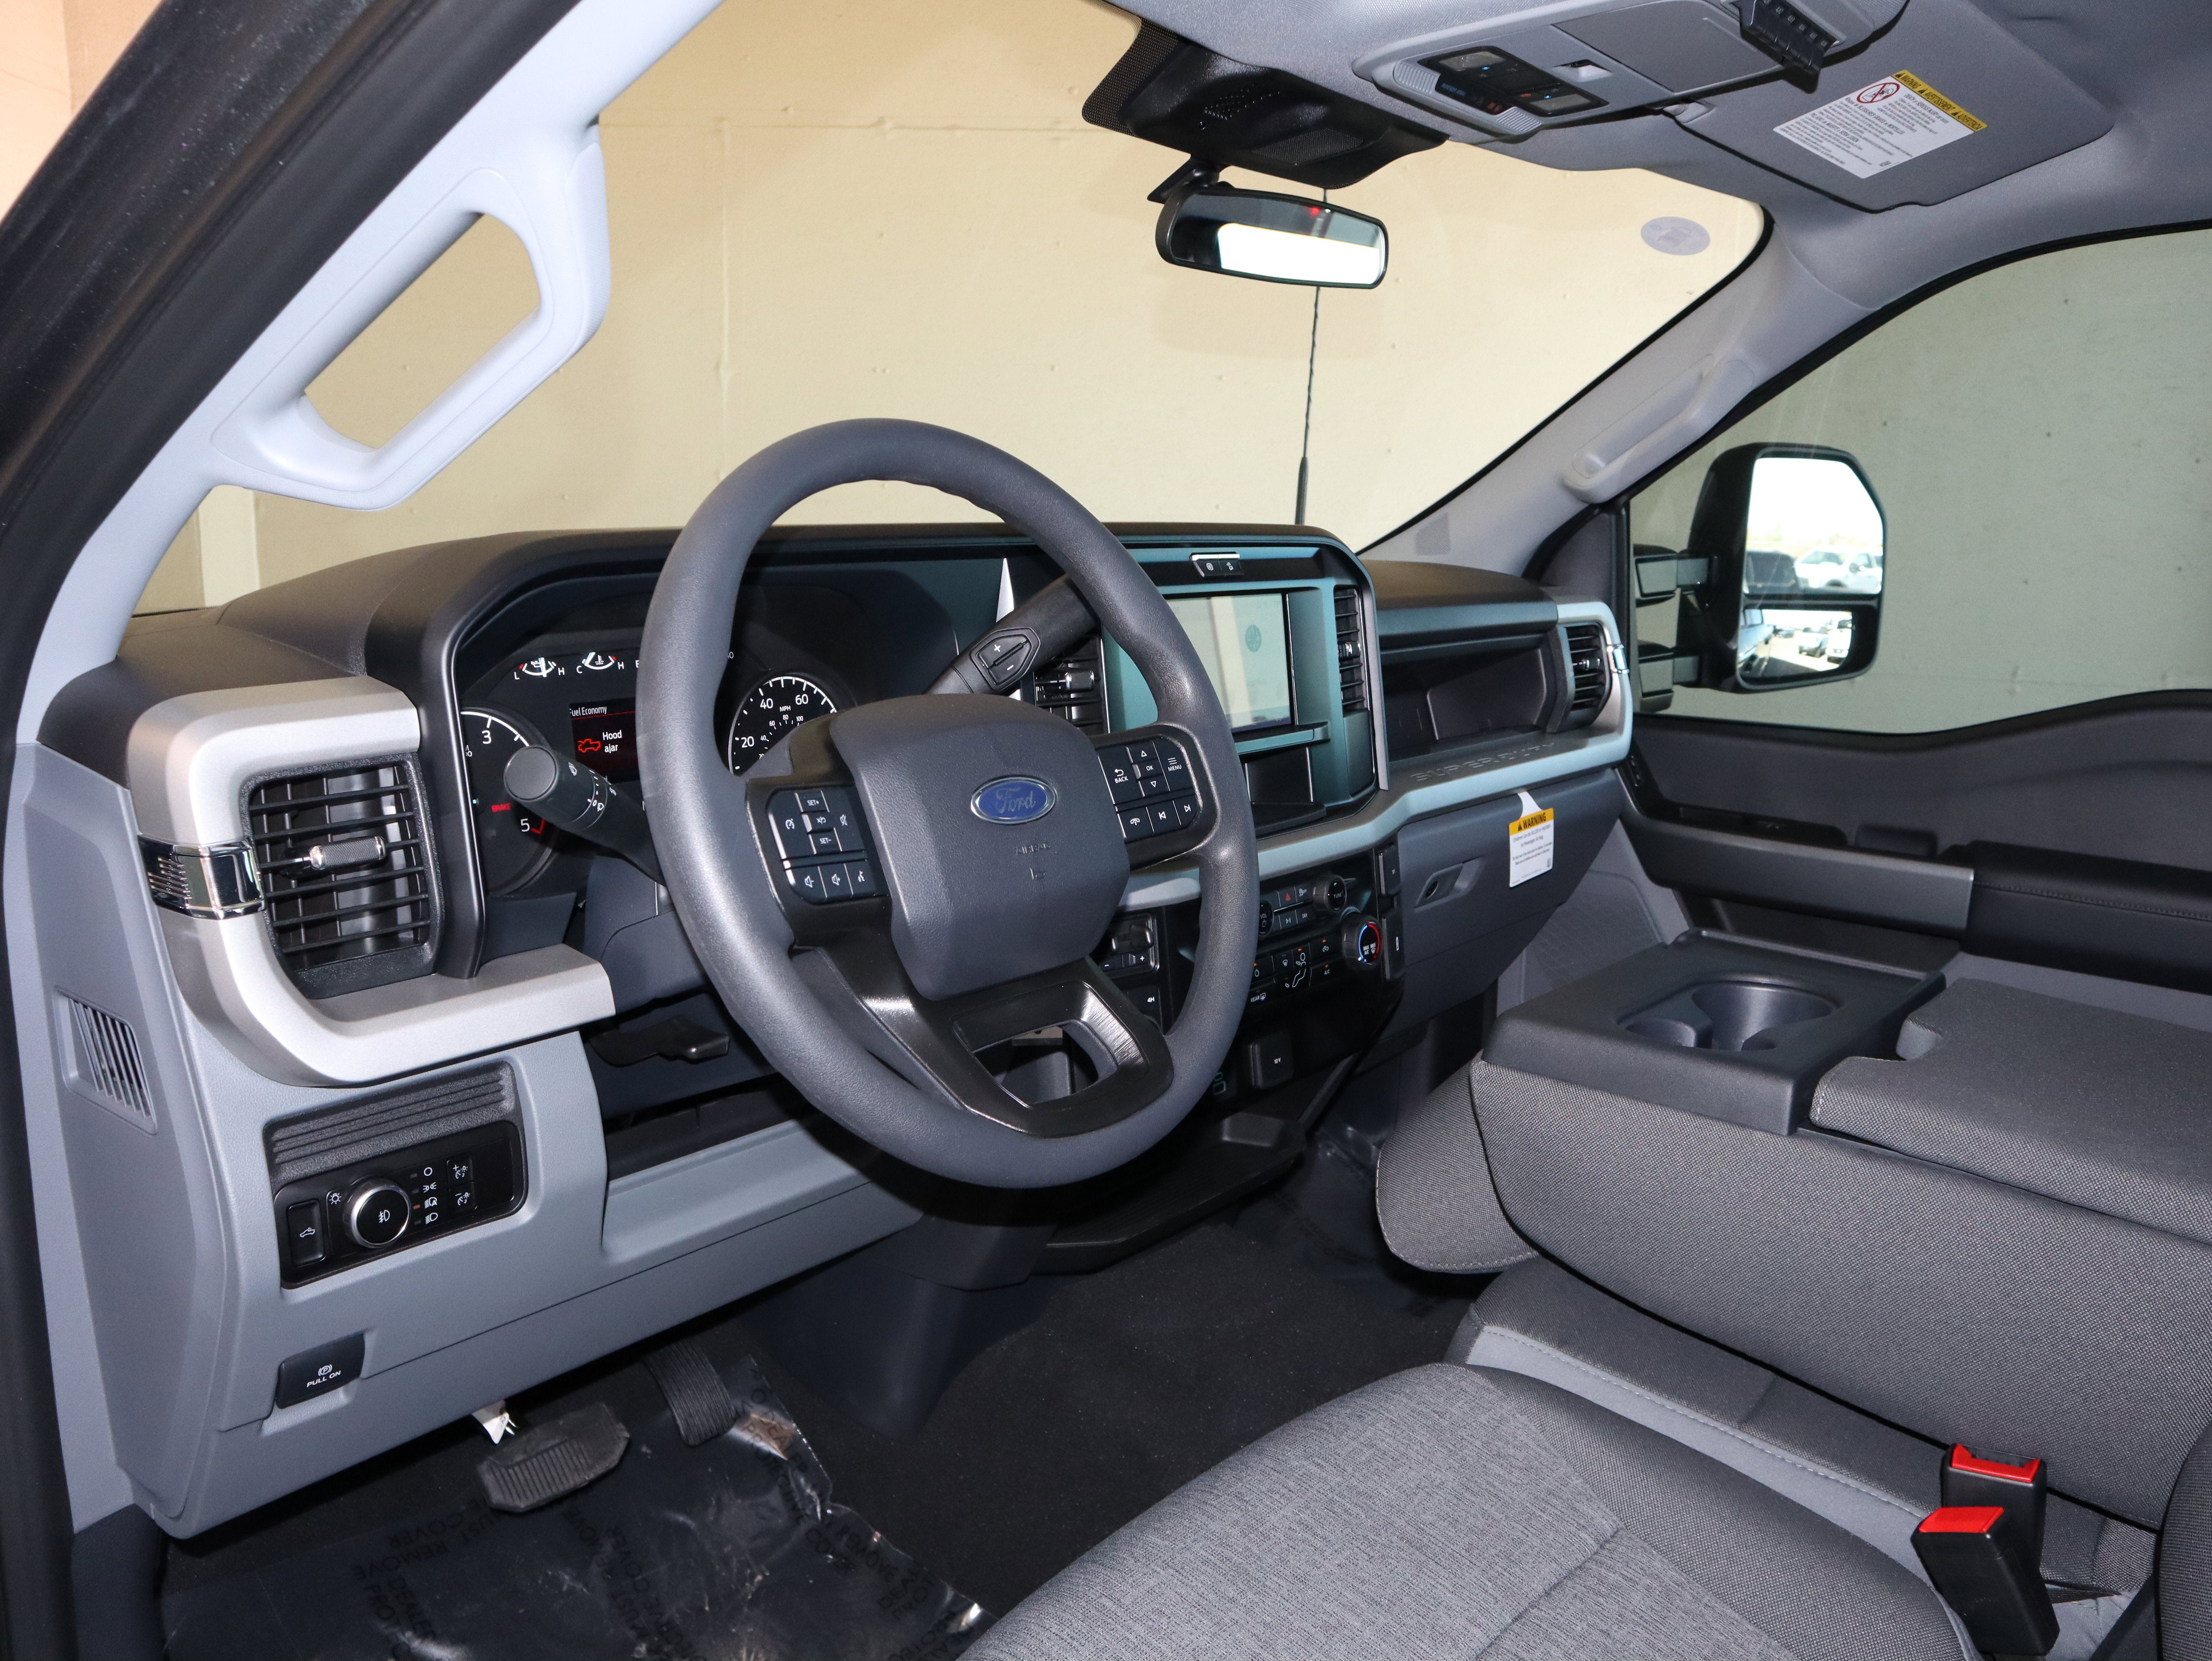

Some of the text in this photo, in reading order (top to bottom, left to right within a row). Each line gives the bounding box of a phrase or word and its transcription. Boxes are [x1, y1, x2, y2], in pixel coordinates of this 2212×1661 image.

[618, 661, 624, 670] H
[514, 671, 520, 680] L
[558, 667, 565, 676] H
[760, 698, 773, 709] 40
[795, 694, 808, 705] 60
[581, 706, 607, 715] Economy
[482, 730, 492, 744] 3
[602, 730, 622, 740] Hood
[741, 736, 754, 748] 20
[604, 744, 618, 753] ajar
[995, 787, 1036, 813] Ford
[520, 818, 530, 832] 5
[1522, 812, 1546, 830] WARNING
[306, 1370, 341, 1388] PULL ON
